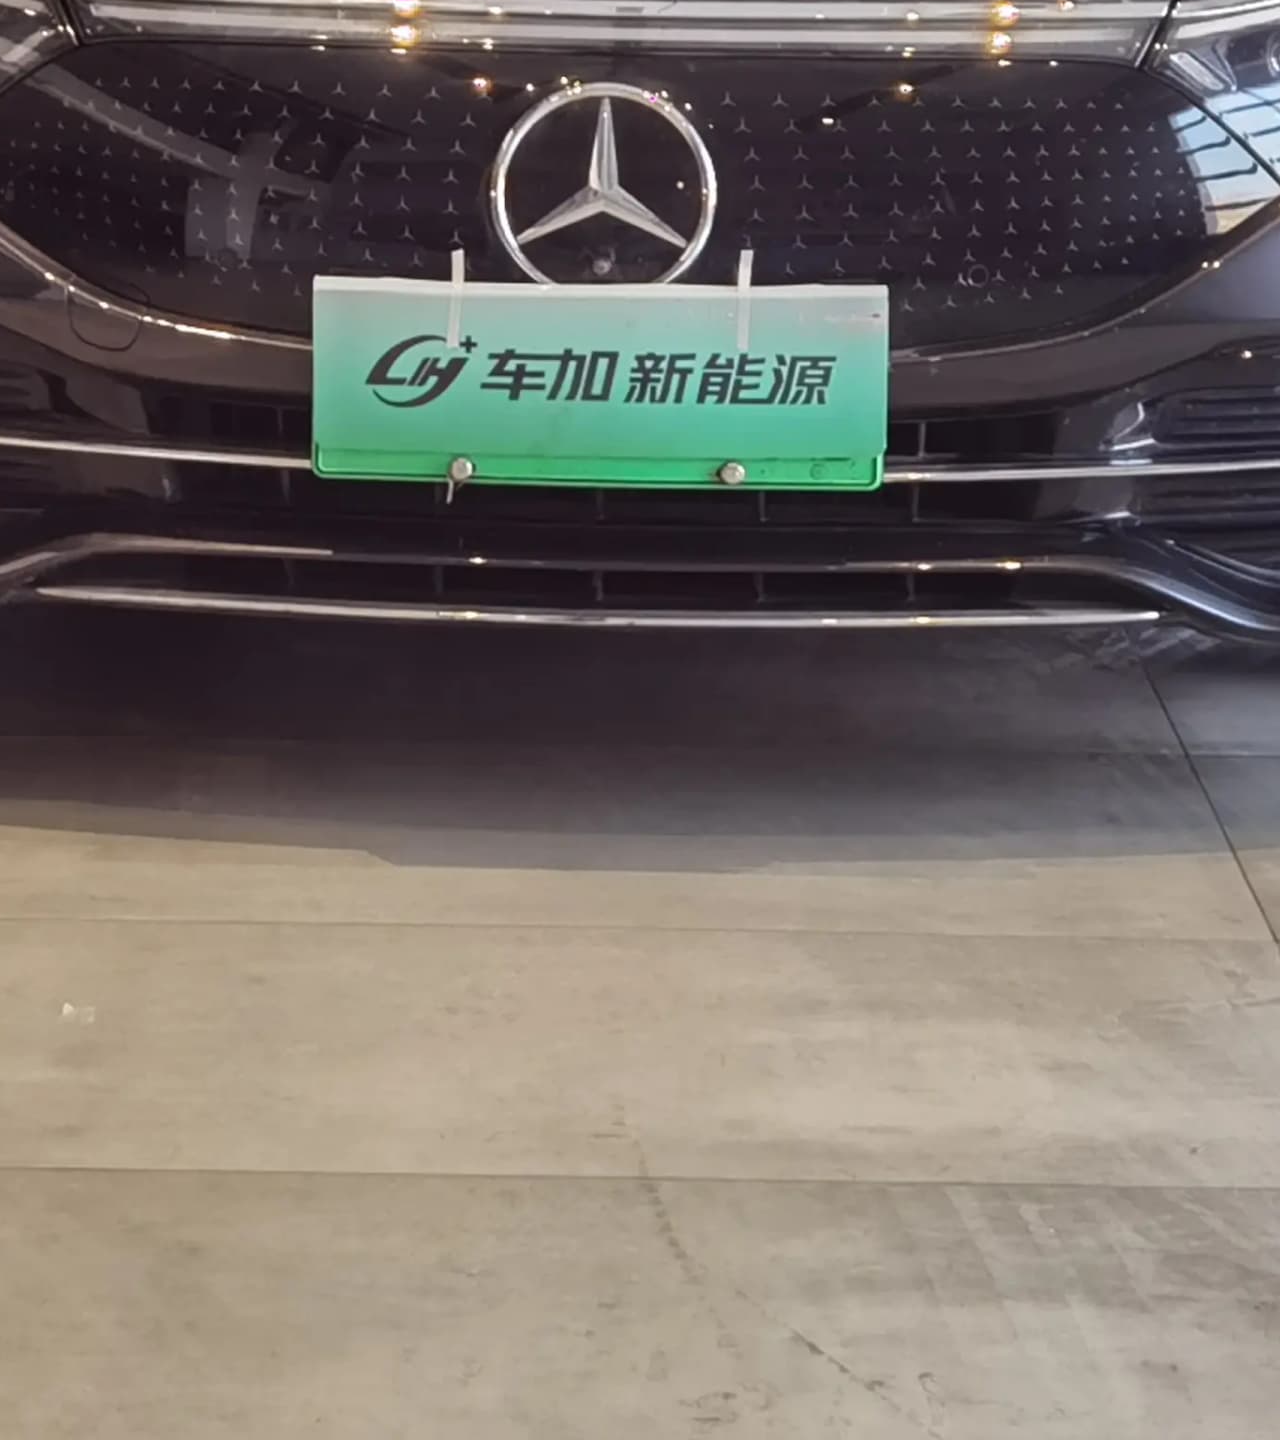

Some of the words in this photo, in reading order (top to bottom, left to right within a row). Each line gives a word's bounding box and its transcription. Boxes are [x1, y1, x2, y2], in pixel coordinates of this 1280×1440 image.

[480, 348, 838, 406] 车加新能源
